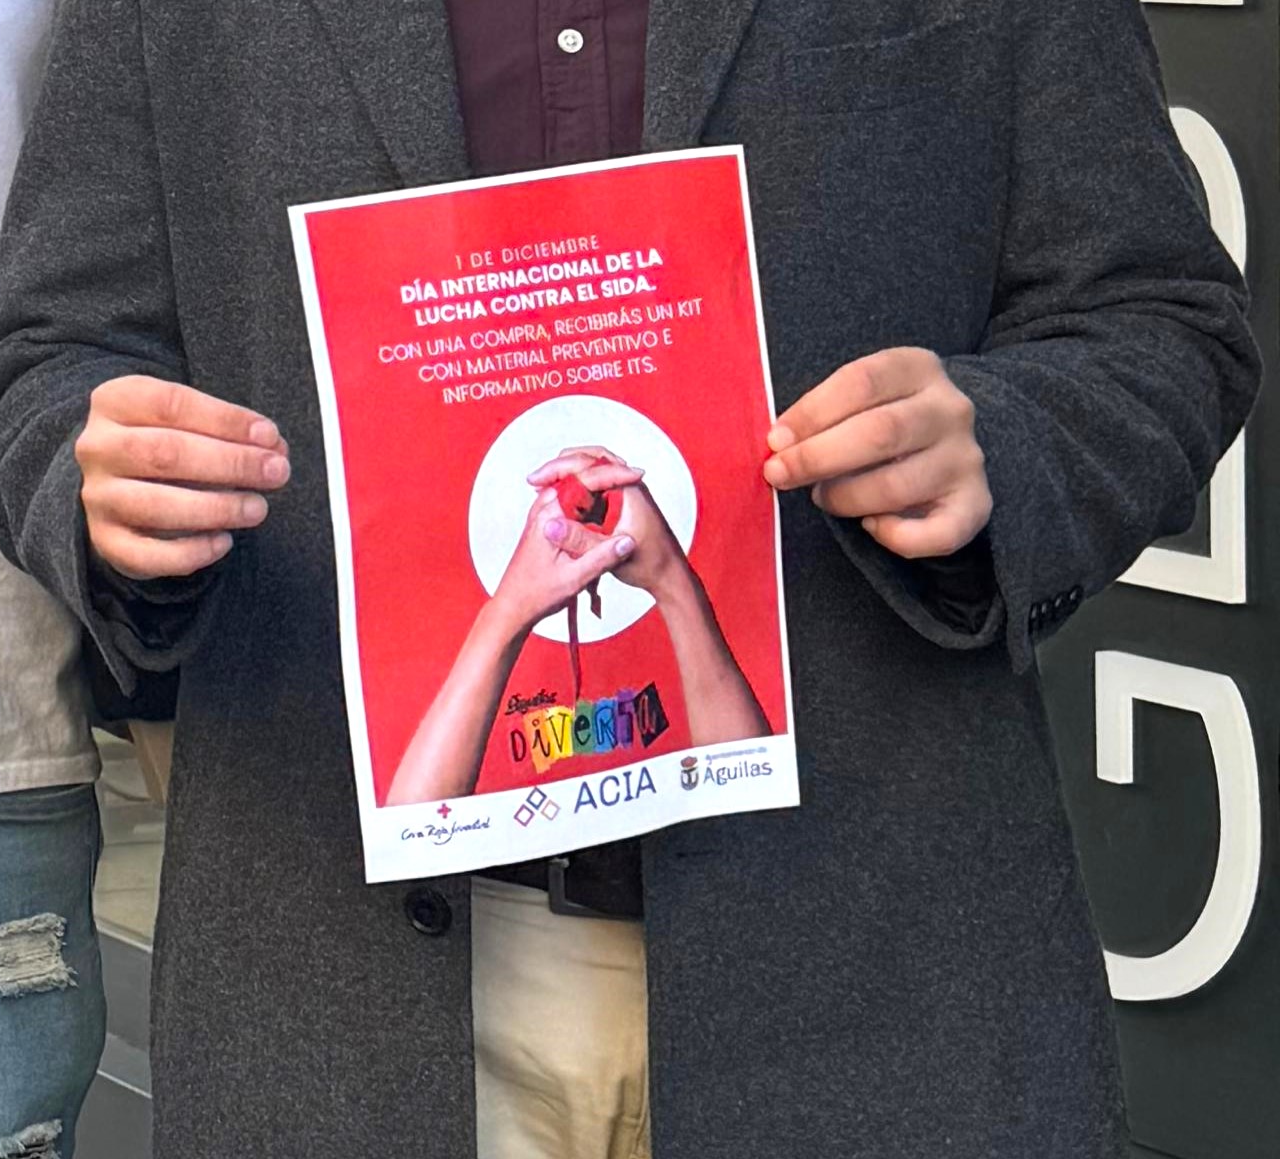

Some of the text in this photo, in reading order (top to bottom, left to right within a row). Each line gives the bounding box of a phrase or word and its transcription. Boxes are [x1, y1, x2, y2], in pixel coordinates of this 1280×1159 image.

[400, 248, 663, 304] DÍA INTERNACIONAL DE LA
[456, 235, 599, 270] 1 DE DICIEMBRE
[415, 275, 657, 327] LUCHA CONTRA EL SIDA.
[378, 298, 702, 364] CON UNA COMPRA, RECIBIRÁS UN KIT
[418, 328, 672, 382] CON MATERIAL PREVENTIVO E
[442, 356, 658, 404] INFORMATIVO SOBRE ITS.
[574, 767, 657, 814] ACIA
[703, 760, 773, 785] Águilas
